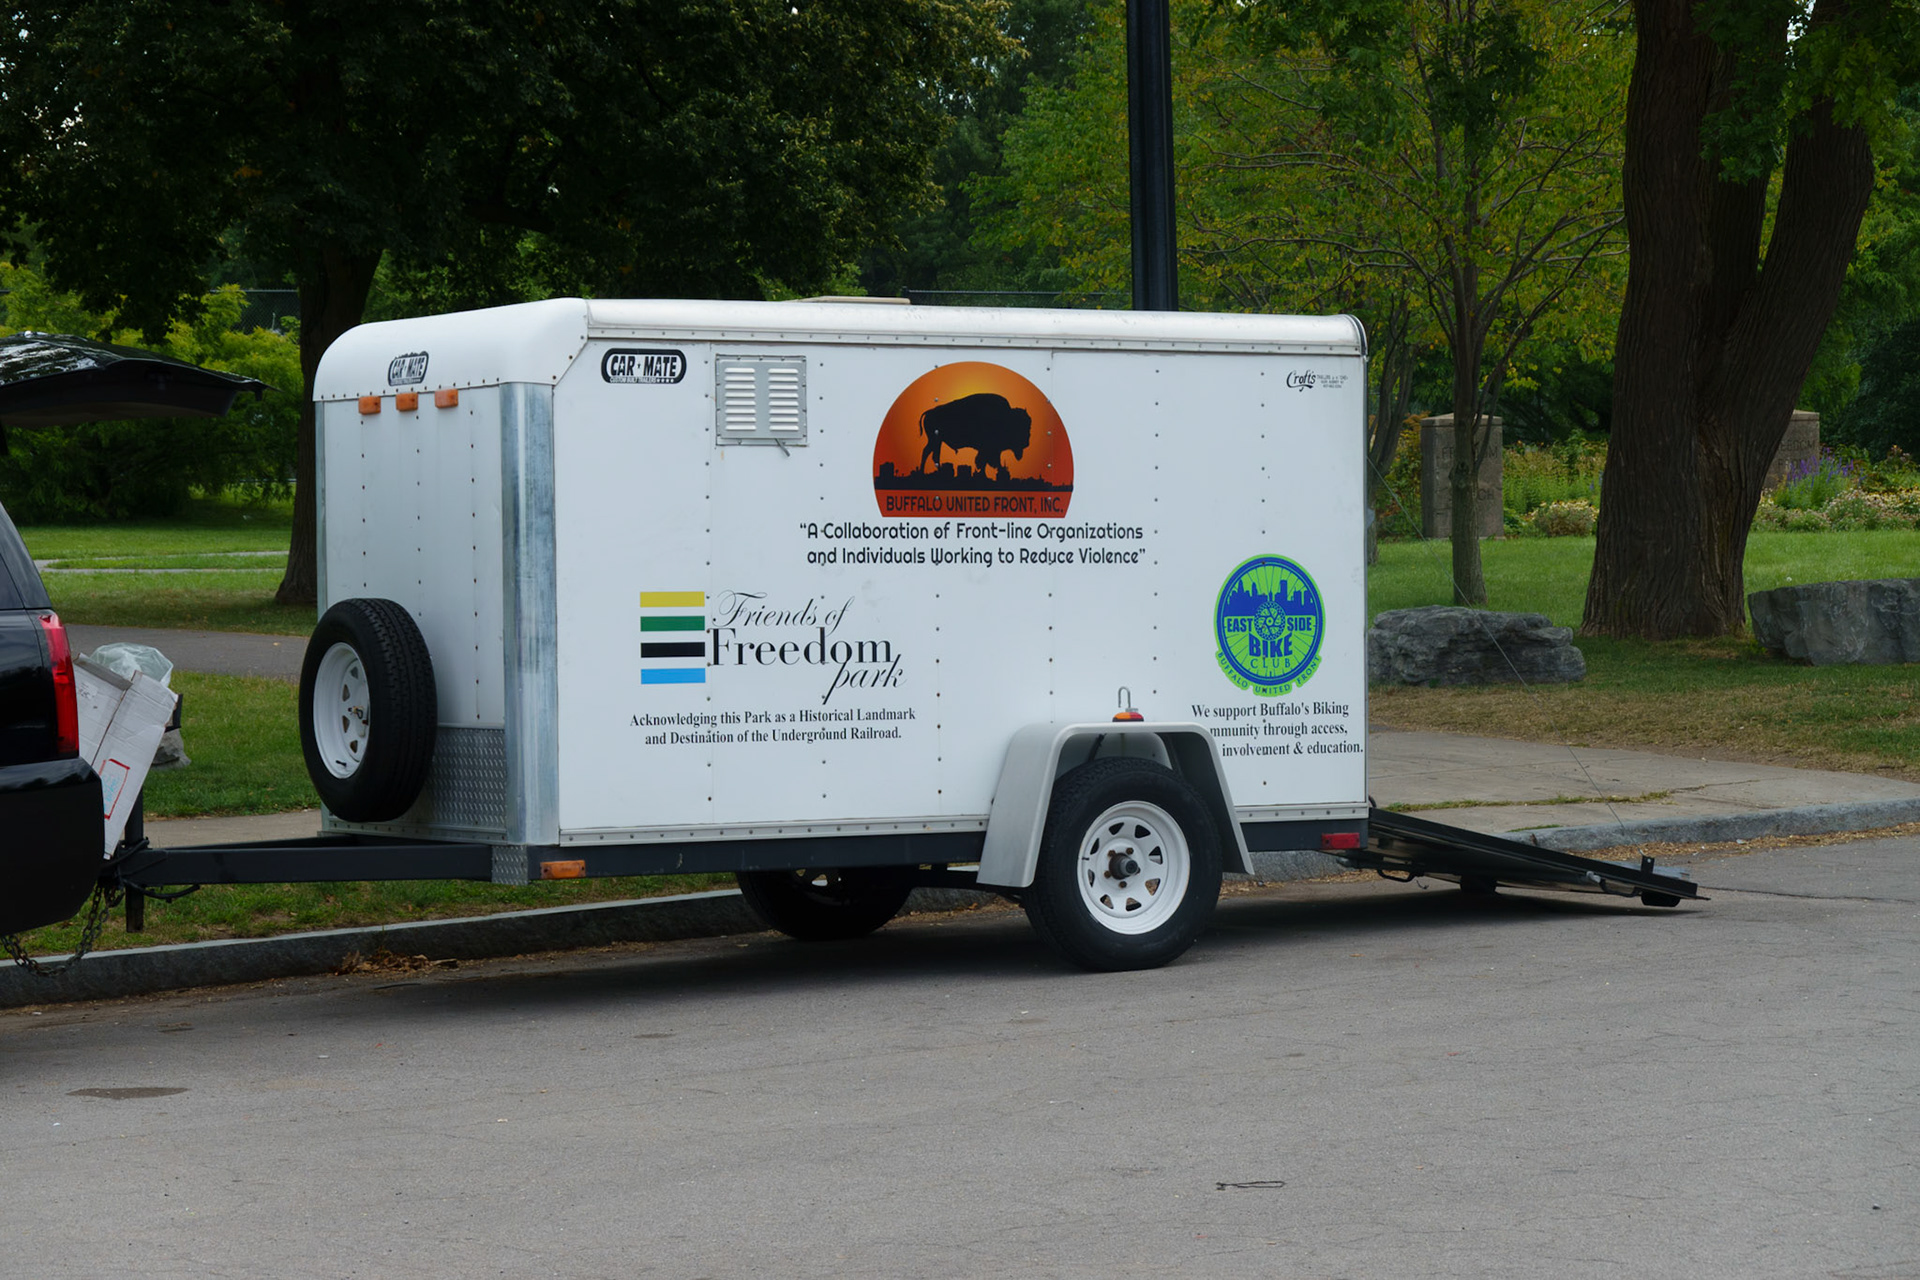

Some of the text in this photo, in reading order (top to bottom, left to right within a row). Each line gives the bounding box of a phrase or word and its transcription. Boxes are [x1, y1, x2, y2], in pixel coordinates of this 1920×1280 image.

[610, 355, 677, 377] CAR MATE
[886, 496, 1064, 514] BUFFALO UNITED FRONT, INC.
[823, 522, 929, 539] Collaboration
[933, 521, 951, 539] of
[956, 522, 1032, 539] Front-line
[1037, 522, 1143, 543] Organizations
[807, 547, 837, 564] and
[842, 547, 926, 564] Individuals
[930, 547, 993, 568] Working
[998, 547, 1015, 564] to
[1019, 547, 1075, 564] Reduce
[711, 590, 856, 637] Friends of
[1226, 617, 1313, 632] EAST SIDE
[708, 626, 897, 666] Freedom
[1248, 632, 1293, 658] BIKE
[1218, 652, 1320, 694] BUFFALO UNITED FRONT
[1249, 658, 1291, 669] CLUB
[822, 653, 908, 705] park
[630, 707, 916, 728] Acknowledging this Park as a Historical Landmark
[1191, 701, 1349, 721] We support Buffalo's Biking
[645, 726, 902, 745] and Destination of the Underground Railroad.
[1210, 722, 1348, 740] mmunity through access,
[1222, 739, 1363, 757] involvement & education.
